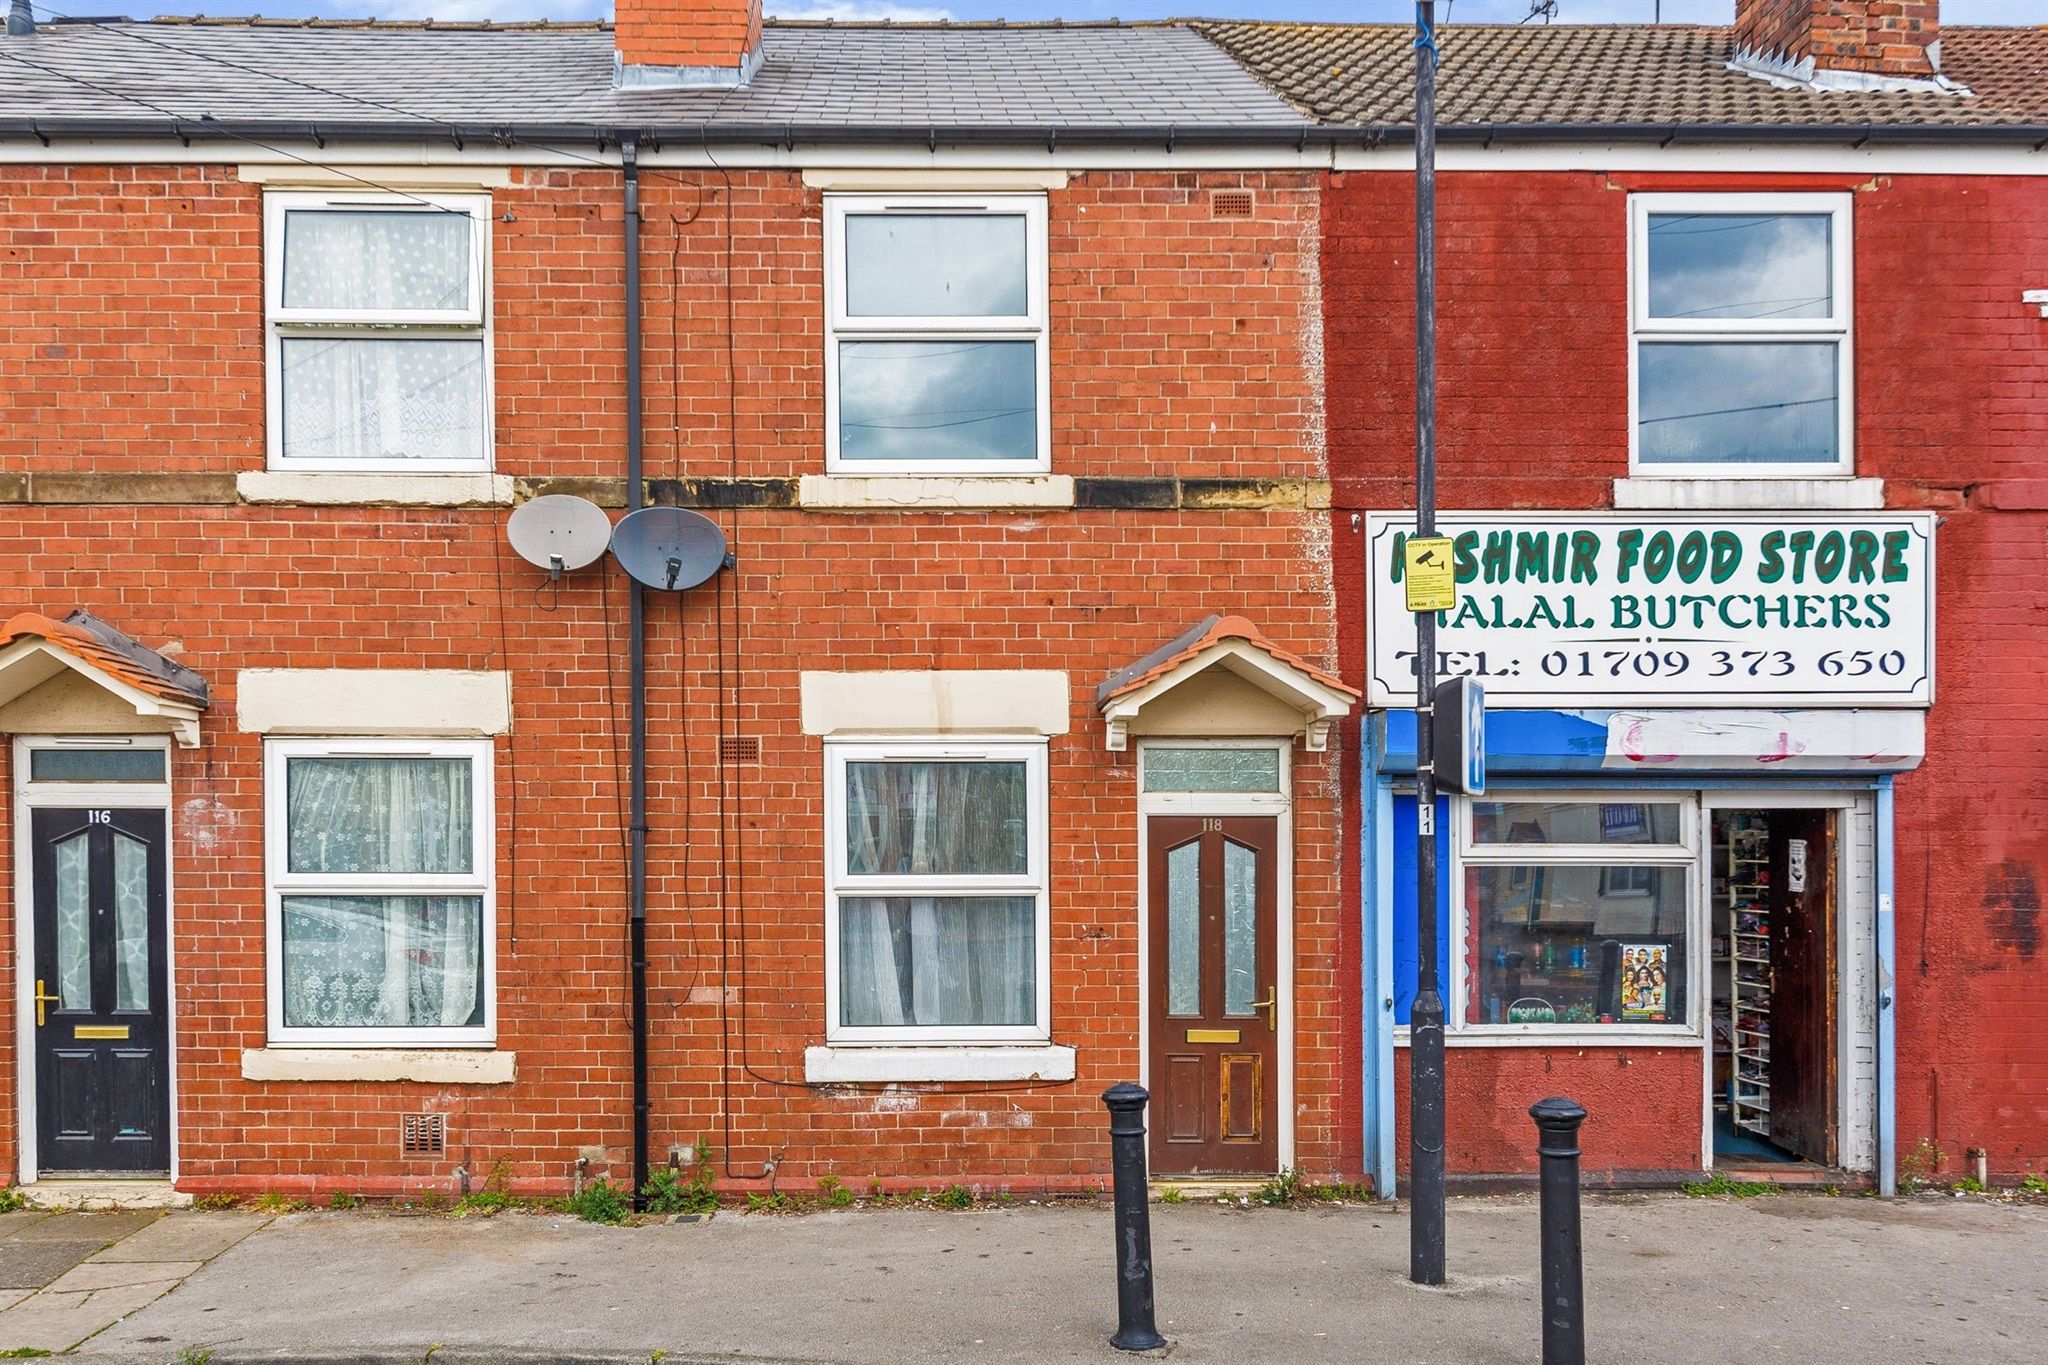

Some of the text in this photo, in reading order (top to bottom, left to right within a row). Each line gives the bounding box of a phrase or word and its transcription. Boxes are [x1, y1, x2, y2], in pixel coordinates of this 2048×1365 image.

[1391, 529, 1910, 586] KSHMIR FOOD STORE
[1415, 594, 1891, 629] ALAL BUTCHERS
[1541, 650, 1690, 677] 01709
[1708, 650, 1796, 677] 373
[1817, 650, 1906, 677] 650
[88, 809, 111, 824] 116
[1202, 818, 1222, 832] 118
